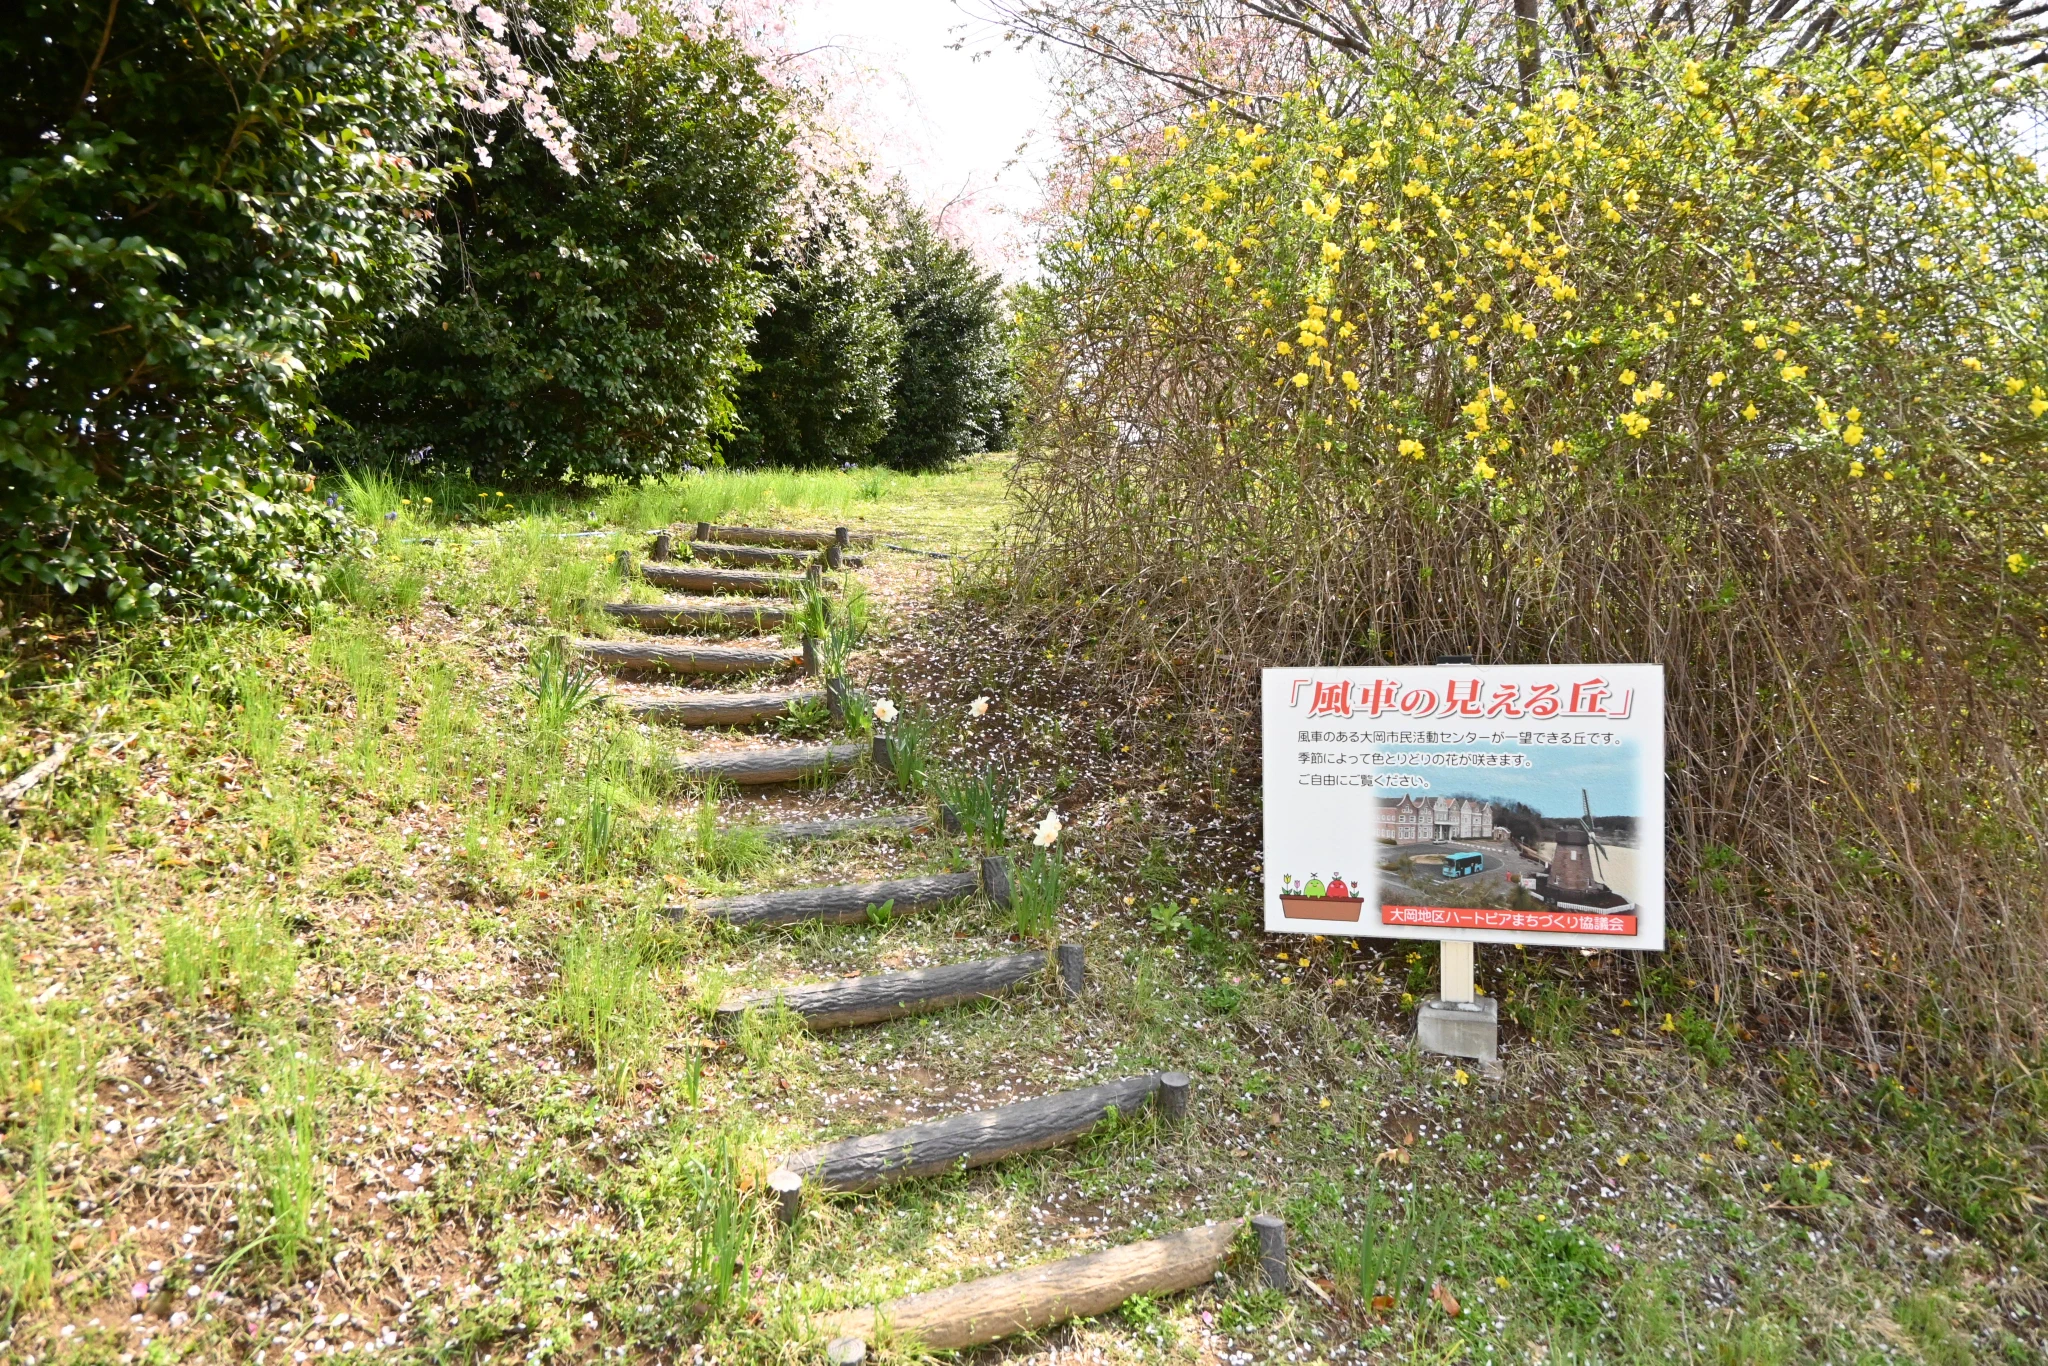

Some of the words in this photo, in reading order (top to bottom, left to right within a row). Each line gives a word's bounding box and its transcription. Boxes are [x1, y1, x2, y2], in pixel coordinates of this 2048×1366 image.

[1290, 678, 1634, 718] 「風車の見える丘」
[1297, 730, 1621, 746] 風車のある大岡市民活動センターが一望できる丘です。
[1297, 751, 1532, 767] 季節によって色とりどりの花が咲きます。
[1298, 773, 1430, 788] ご自由にご覧ください。
[1390, 907, 1624, 932] 大岡地区ハートピアまちづくり協議会
